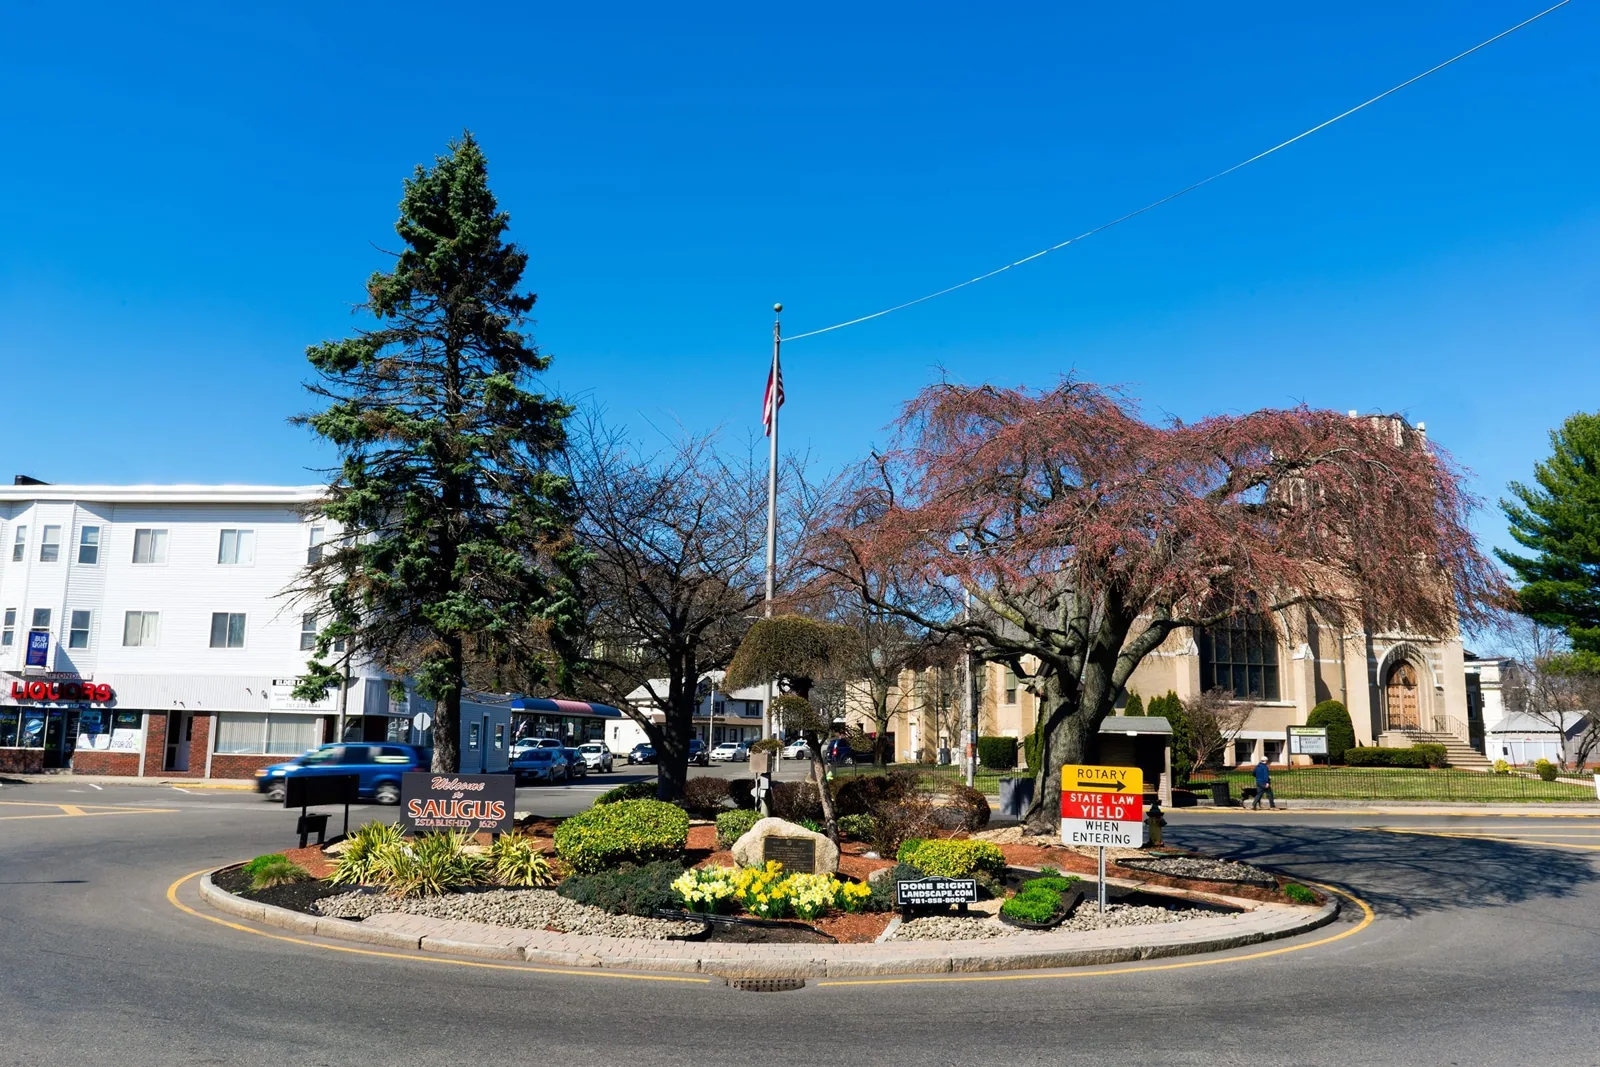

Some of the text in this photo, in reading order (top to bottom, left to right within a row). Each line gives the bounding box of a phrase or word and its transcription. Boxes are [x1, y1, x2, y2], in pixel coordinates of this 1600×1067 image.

[11, 681, 112, 701] LIQUORS
[1077, 768, 1127, 780] ROTARY
[431, 776, 486, 791] Welcome
[451, 791, 464, 799] to
[1070, 793, 1134, 805] STATE LAW
[407, 798, 506, 820] SAUGUS
[1080, 805, 1125, 819] YIELD
[414, 818, 498, 829] ESTABLISHED 1629
[1085, 820, 1120, 832] WHEN
[1072, 831, 1131, 845] ENTERING
[902, 890, 973, 898] LANDSCAPE.COM
